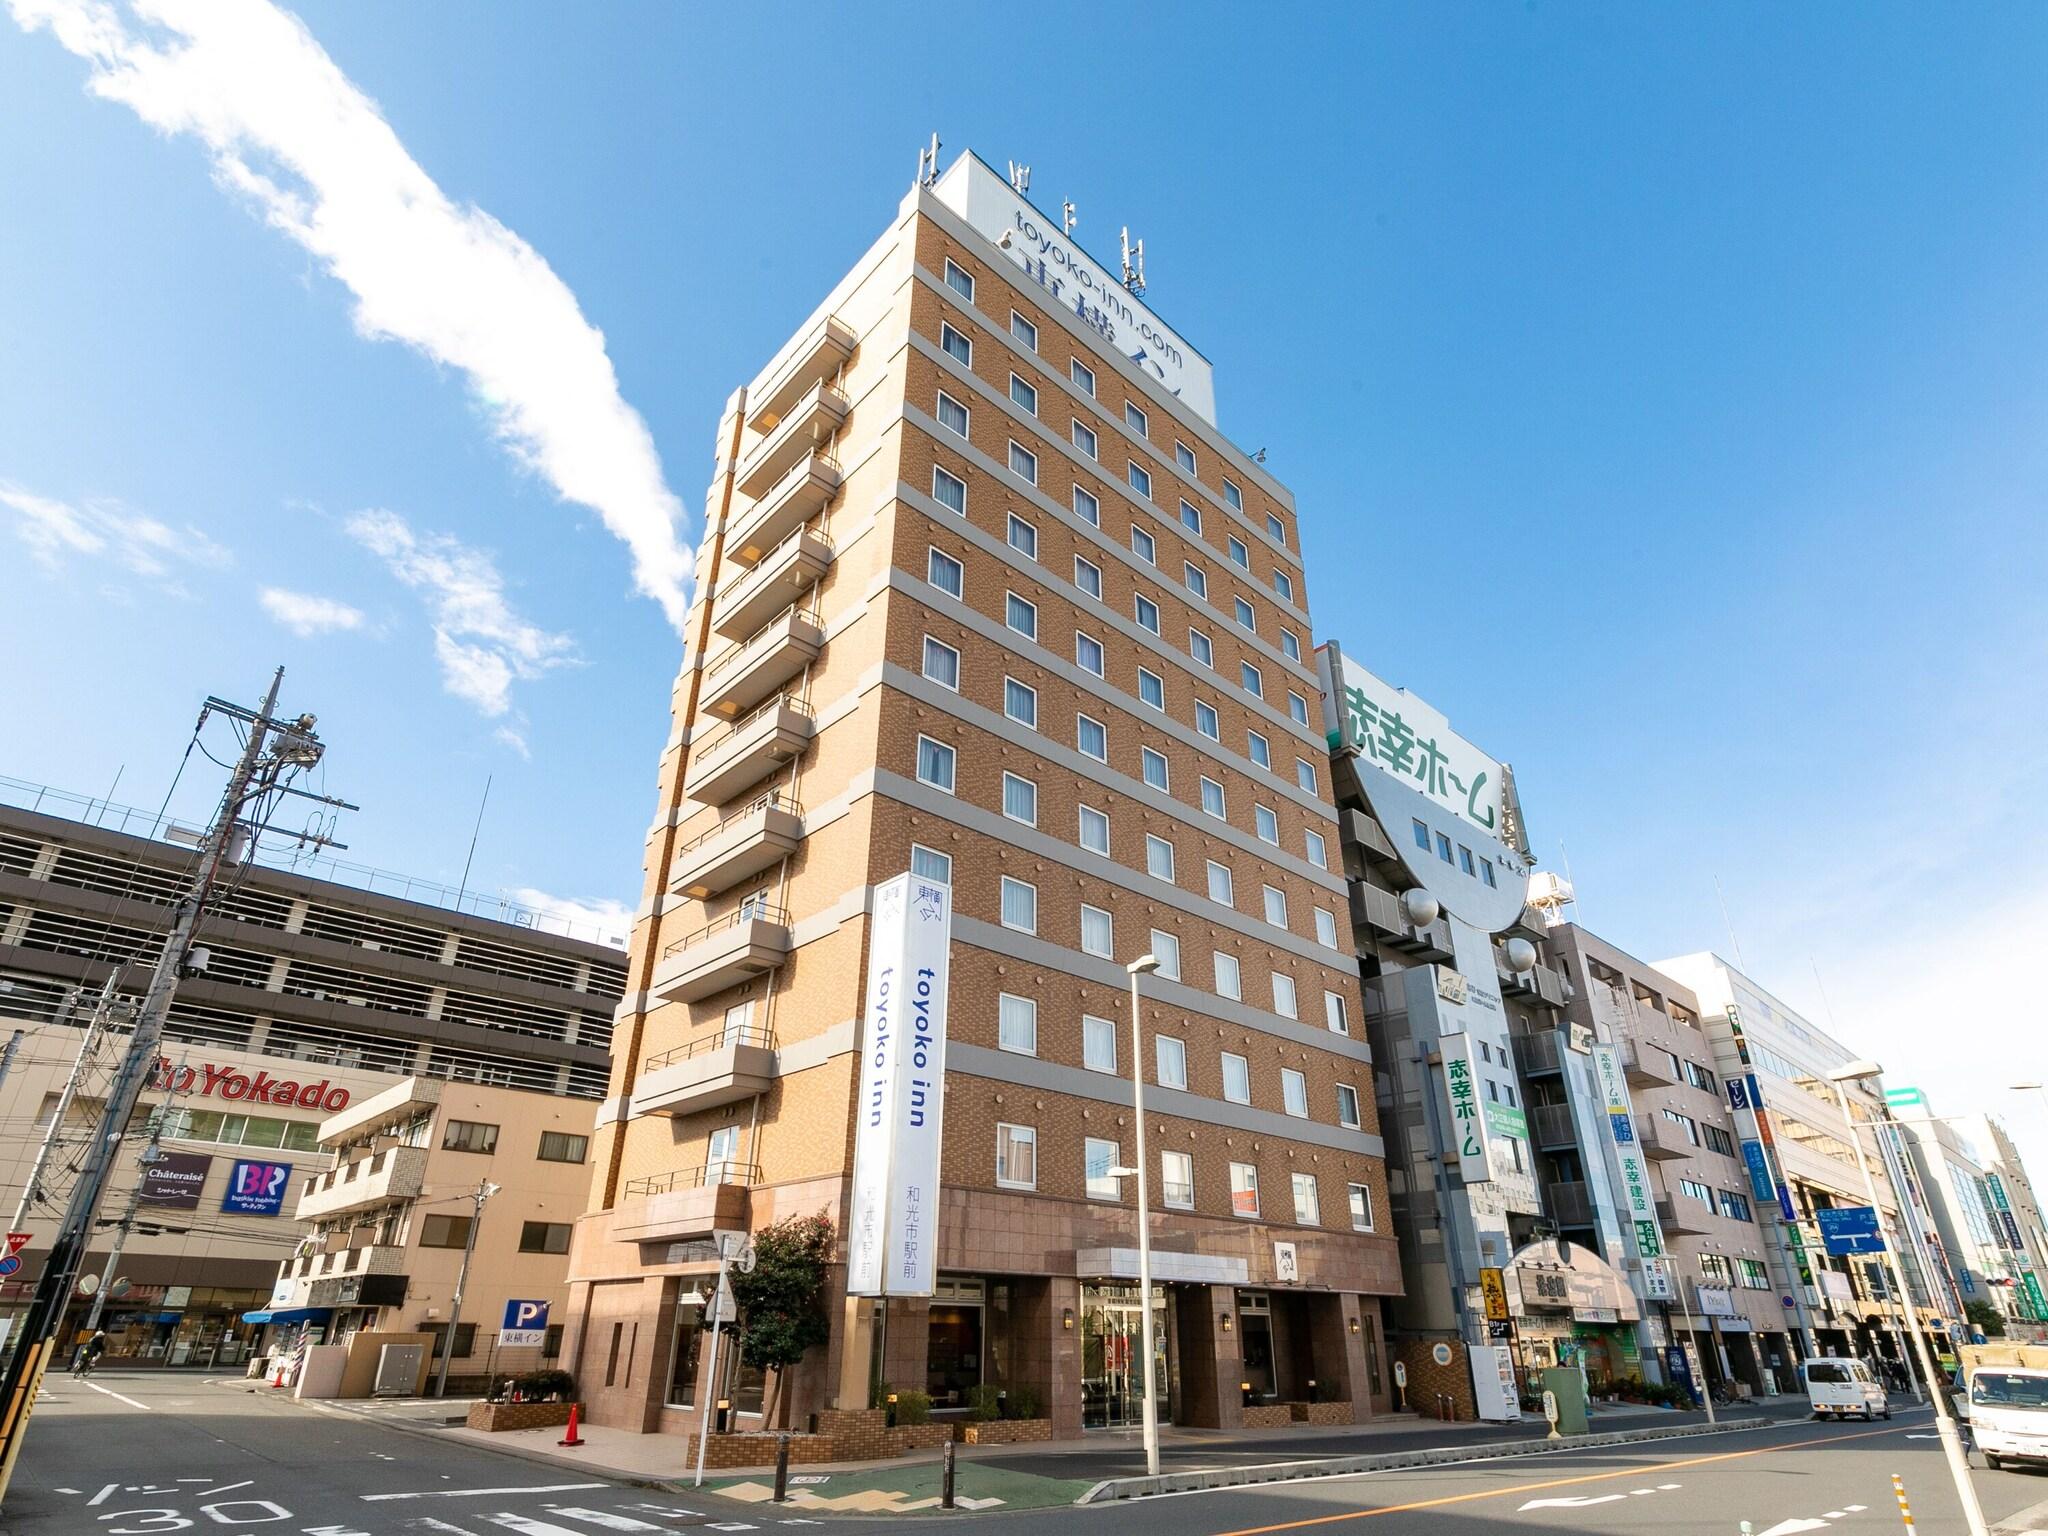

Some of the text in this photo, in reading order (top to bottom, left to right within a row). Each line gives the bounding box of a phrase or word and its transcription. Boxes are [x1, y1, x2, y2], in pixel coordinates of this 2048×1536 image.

[1015, 209, 1184, 369] toyoko-inn.com
[870, 966, 894, 1128] toyoko inn
[909, 968, 937, 1128] toyoko inn
[199, 1063, 351, 1113] Yokado
[1447, 1059, 1482, 1157] 志幸ホーム
[148, 1169, 205, 1182] Châteraisé
[1623, 1158, 1648, 1211] 志幸建設
[903, 1185, 921, 1280] 和光市駅前
[503, 1332, 543, 1345] 東横イン
[516, 1302, 538, 1327] P
[97, 1500, 294, 1534] 30
